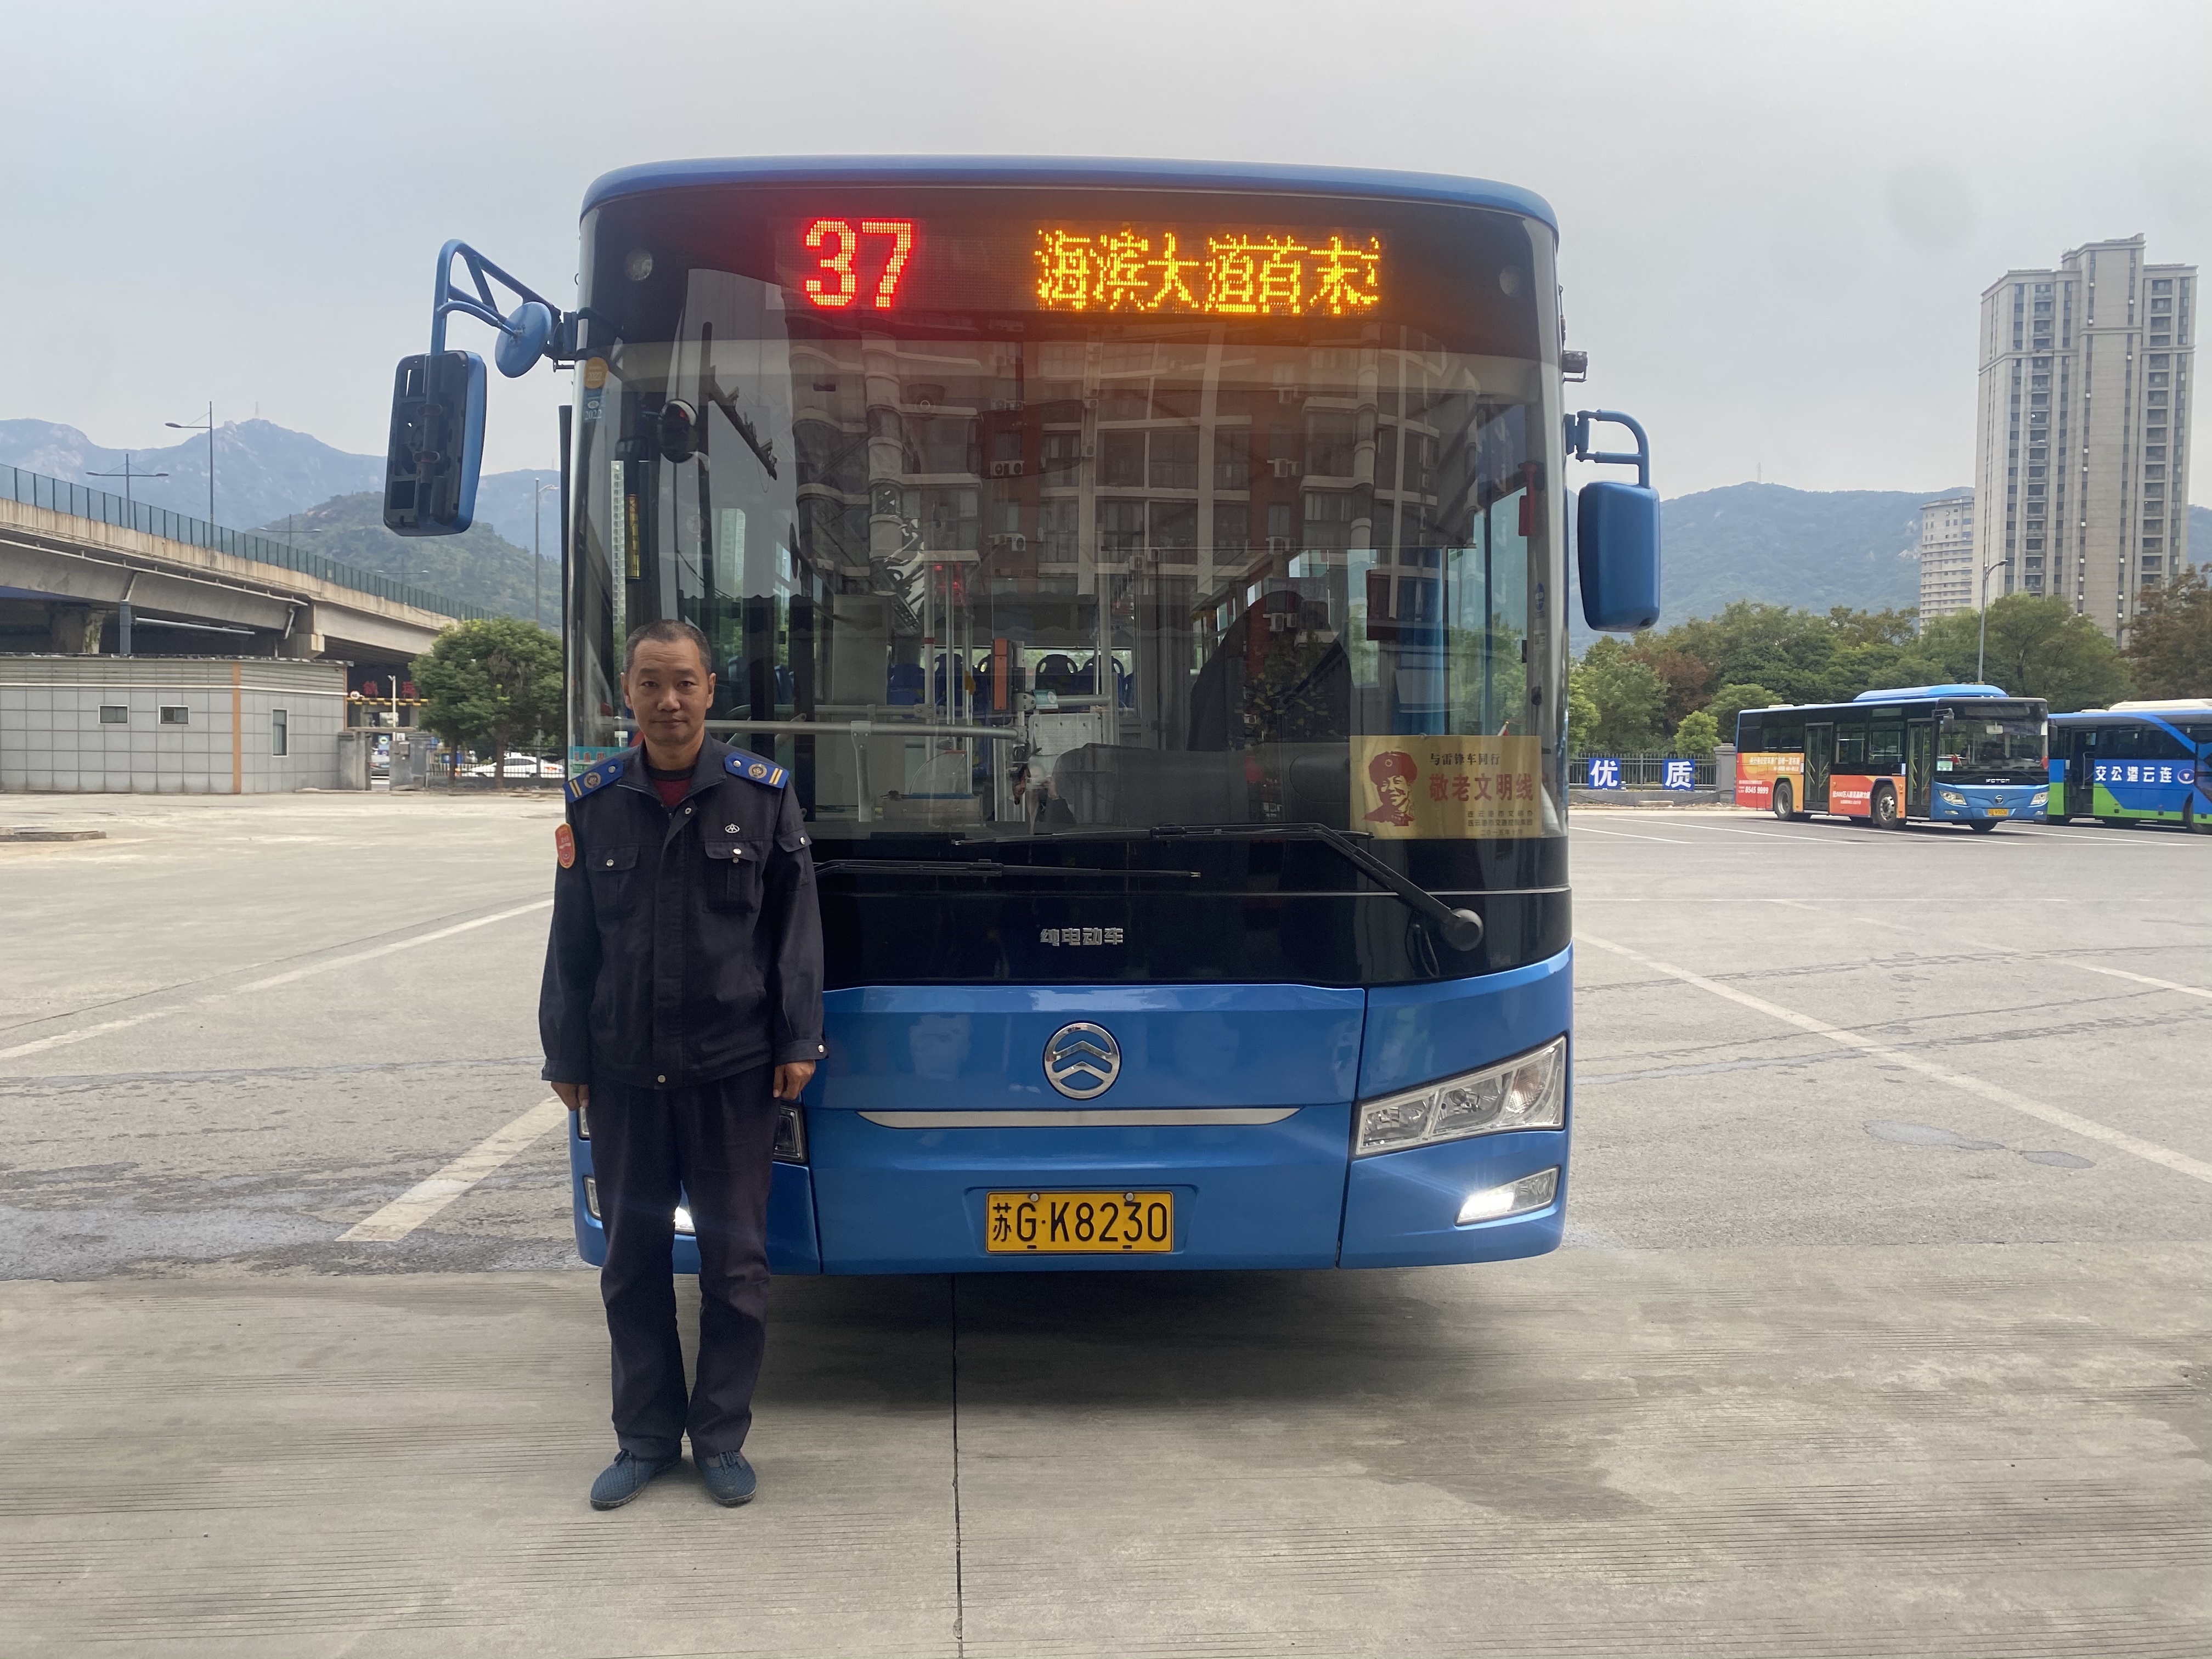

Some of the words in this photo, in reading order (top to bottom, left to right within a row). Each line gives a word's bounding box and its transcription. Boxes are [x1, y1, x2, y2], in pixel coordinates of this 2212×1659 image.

[806, 220, 911, 308] 37
[584, 409, 602, 421] 2022
[1430, 753, 1500, 766] 与雷锋车同行
[1429, 772, 1534, 802] 敬老文明线
[1040, 927, 1124, 946] 纯电动车
